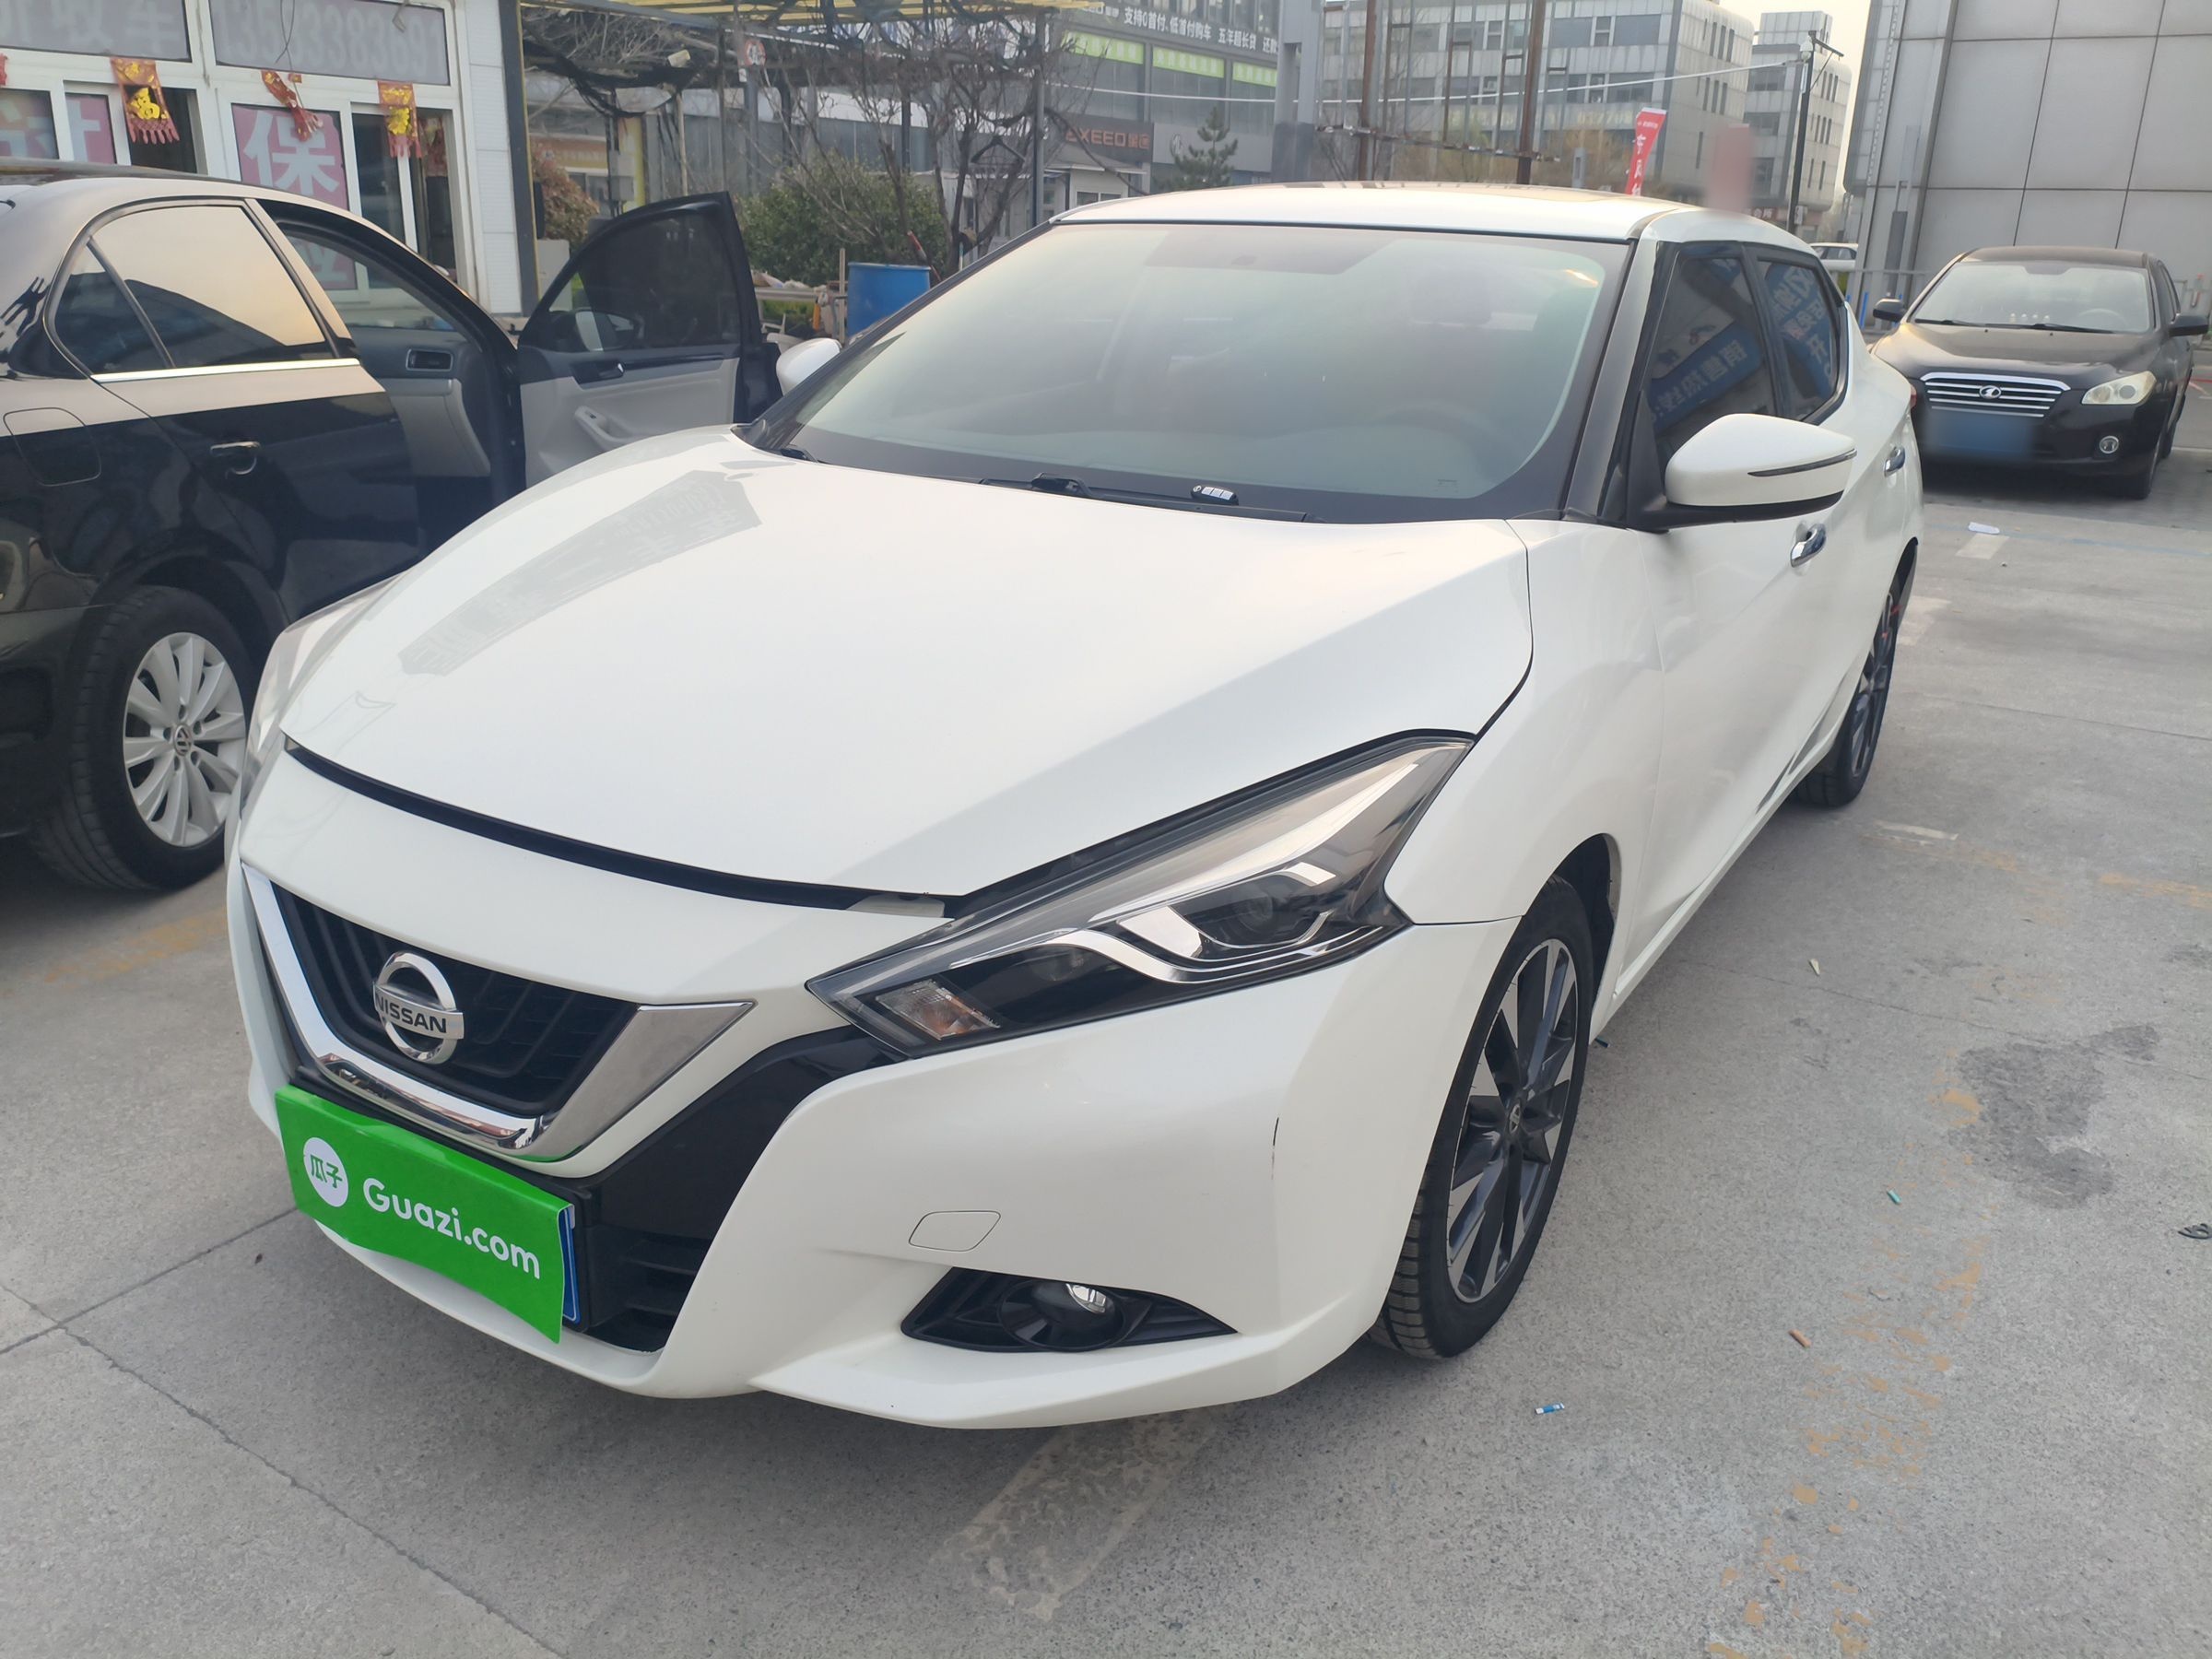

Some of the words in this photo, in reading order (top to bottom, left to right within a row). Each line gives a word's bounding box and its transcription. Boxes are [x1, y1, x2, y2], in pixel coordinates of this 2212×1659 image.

[376, 993, 447, 1034] NISSAN
[309, 1154, 343, 1190] 瓜子
[363, 1177, 541, 1279] Guazi.com
